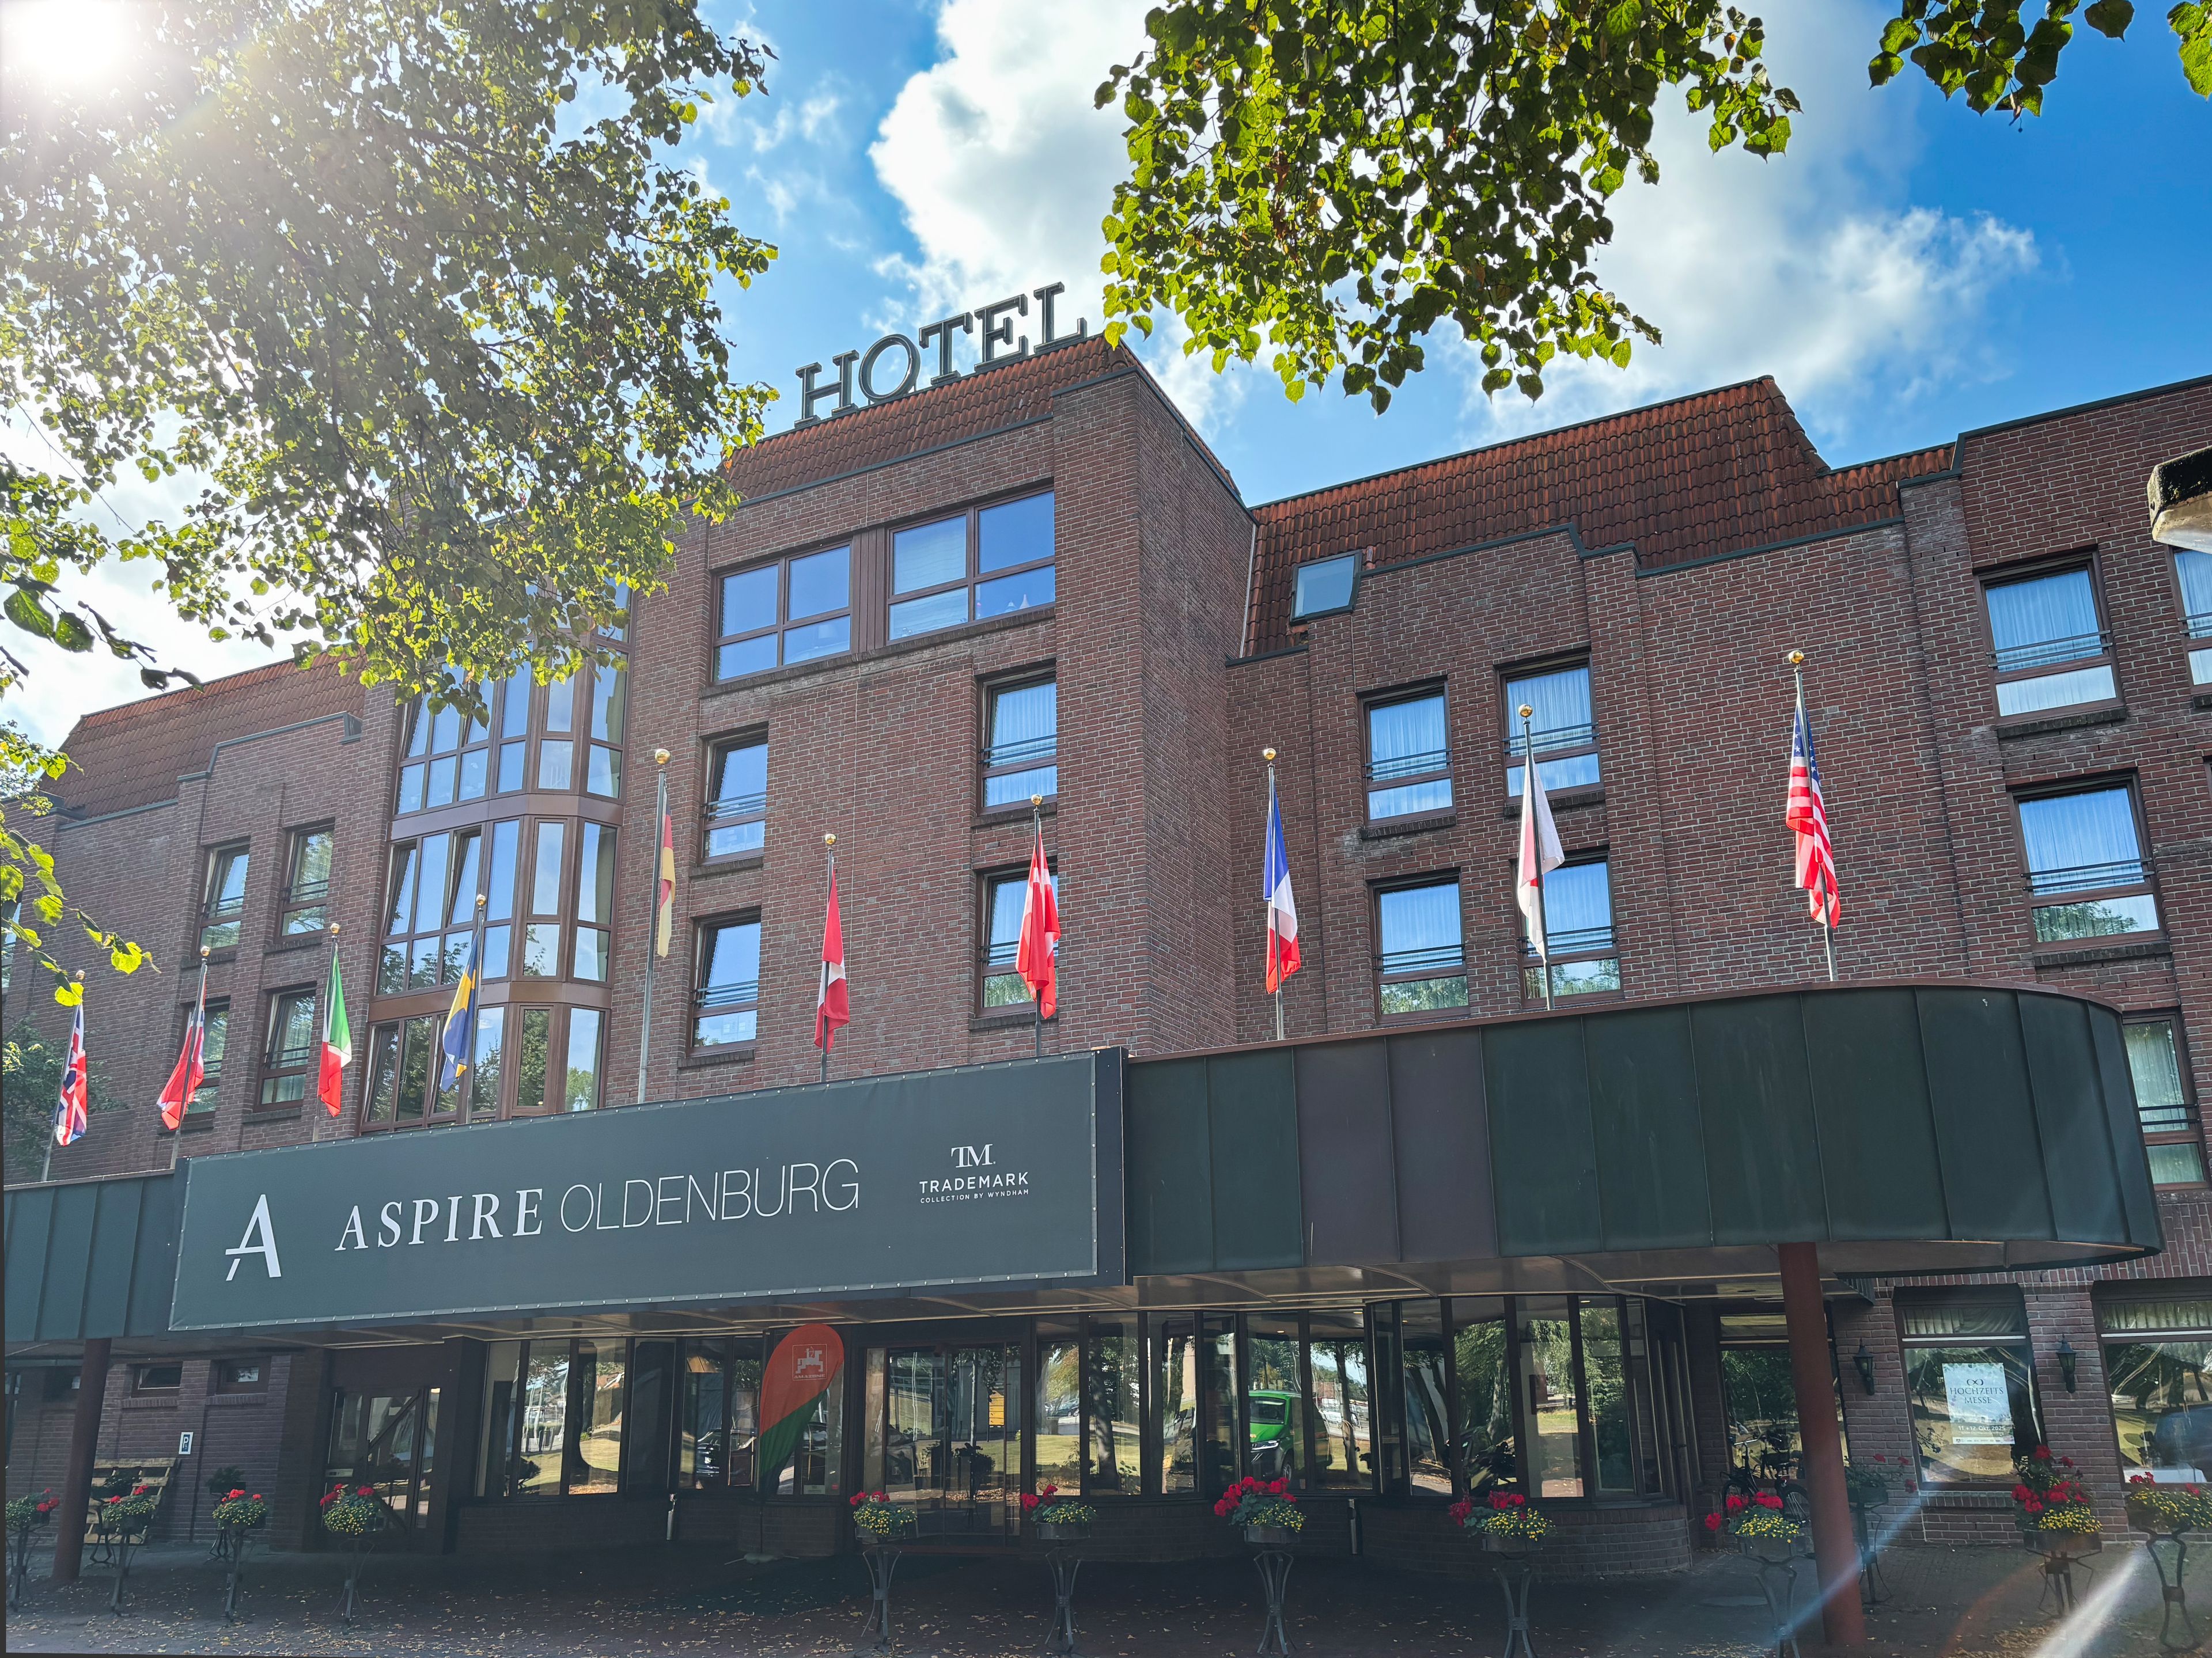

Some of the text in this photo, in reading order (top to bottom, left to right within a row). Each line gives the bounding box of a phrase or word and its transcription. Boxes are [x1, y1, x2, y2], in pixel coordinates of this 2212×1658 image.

[794, 282, 1087, 428] HOTEL
[335, 1159, 859, 1251] ASPIRE OLDENBURG
[919, 1171, 1028, 1194] TRADEMARK
[921, 1194, 970, 1204] COLLECTION
[987, 1189, 1029, 1198] WYNDHAM
[225, 1194, 281, 1281] A
[182, 1436, 189, 1448] P
